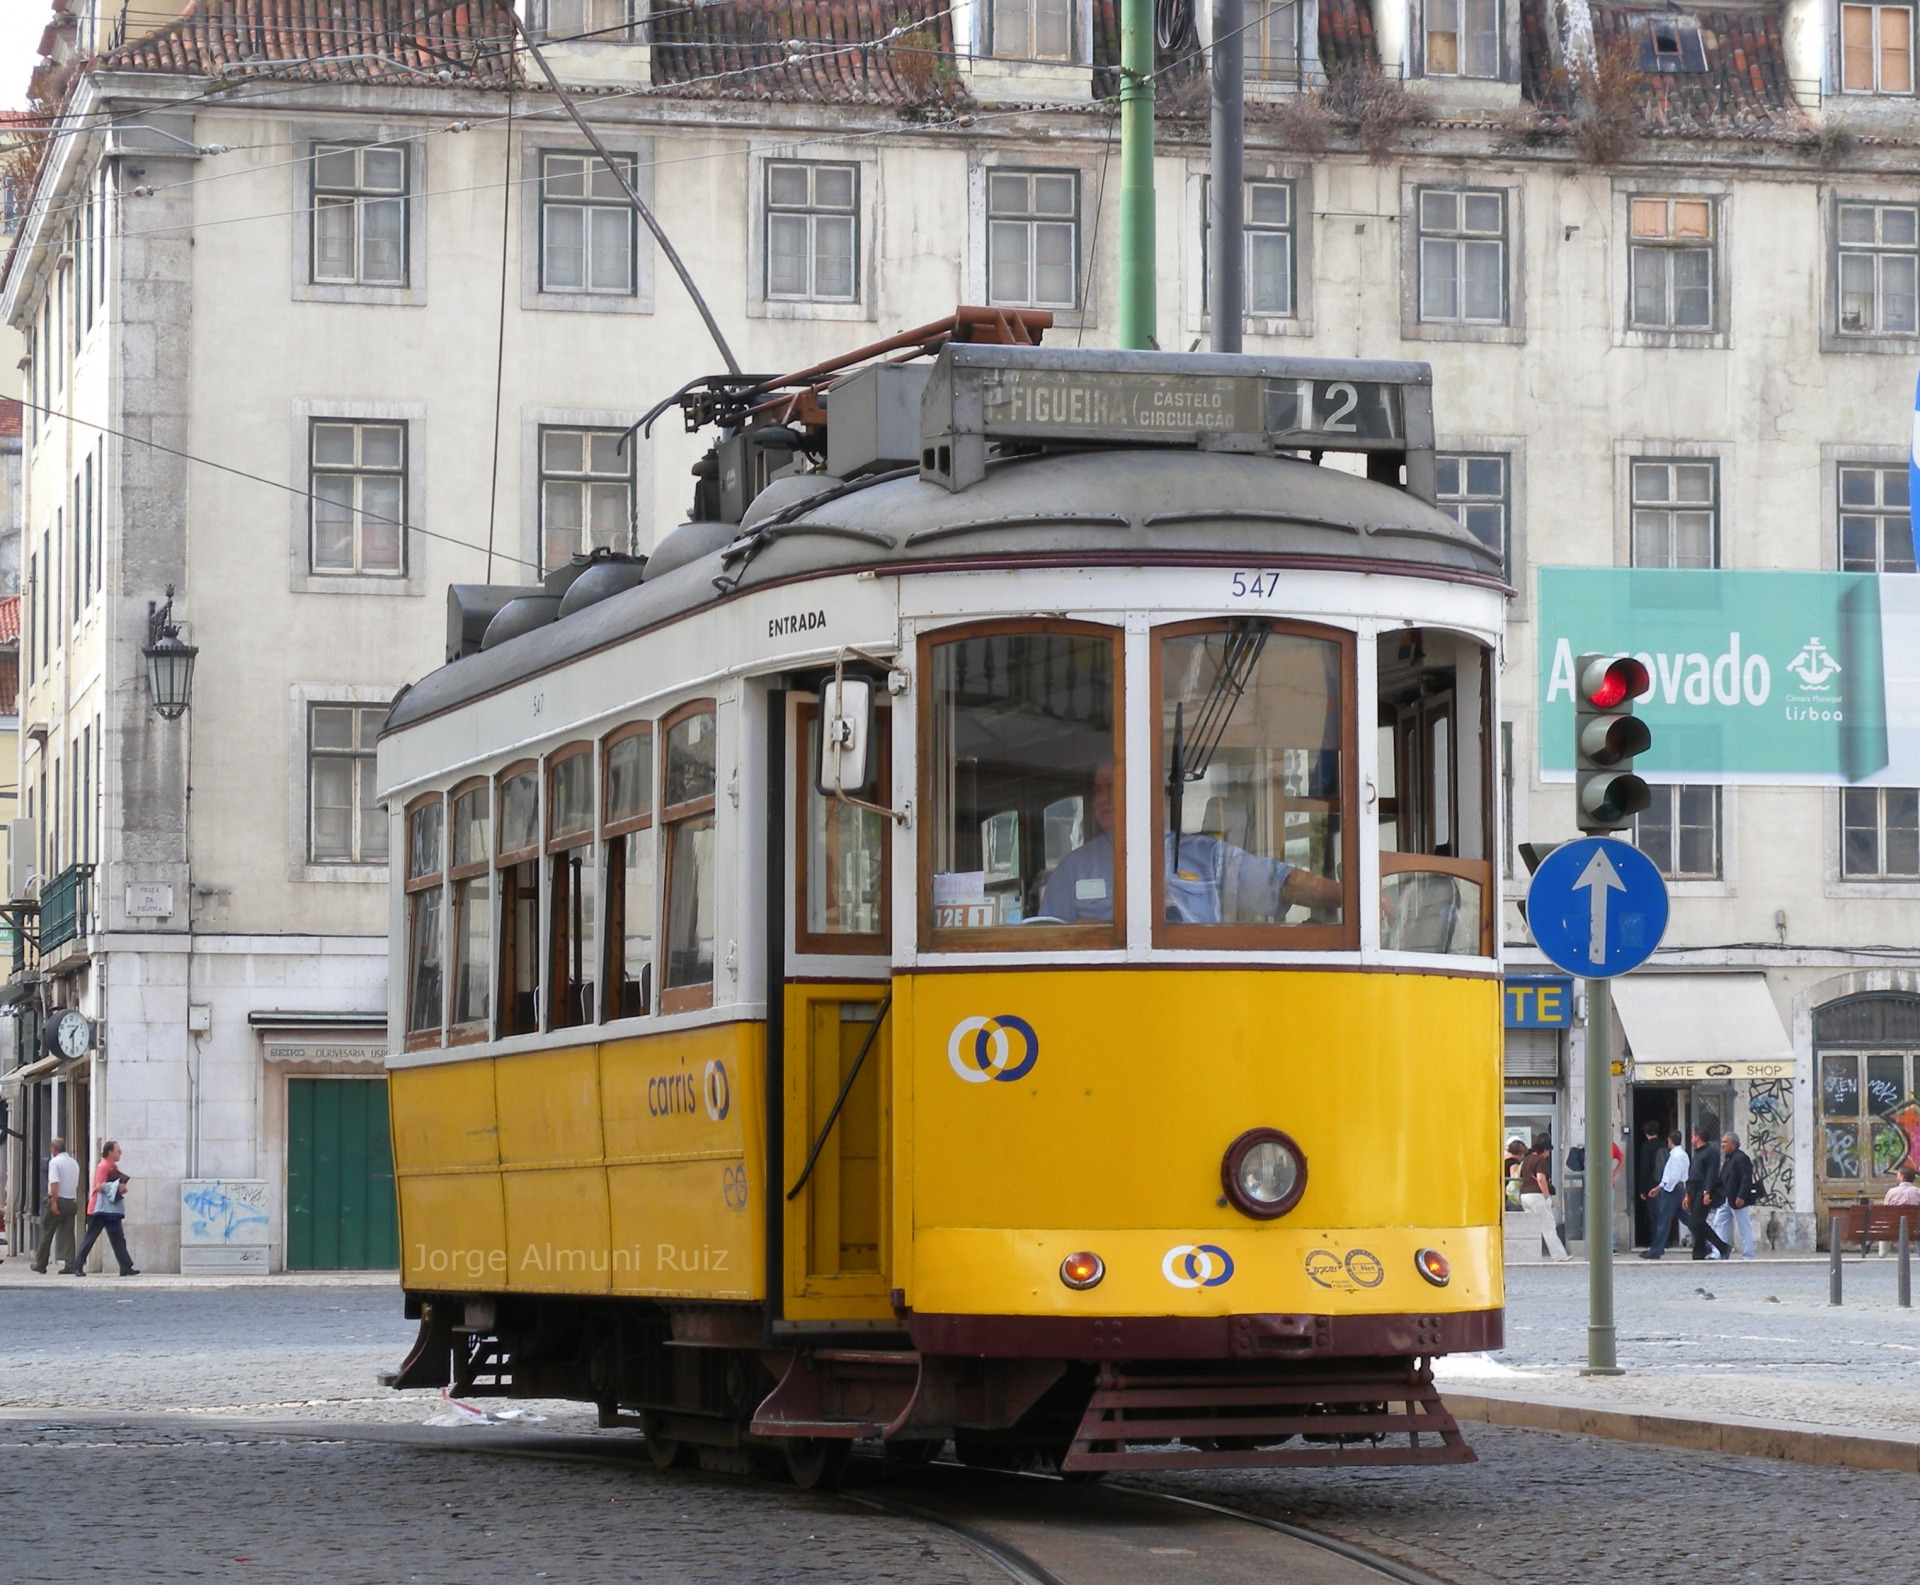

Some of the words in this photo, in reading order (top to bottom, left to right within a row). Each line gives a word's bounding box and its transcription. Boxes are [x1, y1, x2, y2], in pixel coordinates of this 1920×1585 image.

[1011, 386, 1128, 425] FIGUEIRA
[1154, 392, 1221, 408] CASTELO
[1297, 381, 1358, 432] 12
[1140, 411, 1234, 430] CIRCULAÇÃO
[1232, 571, 1280, 598] 547
[768, 609, 827, 638] ENTRADA
[1546, 631, 1772, 706] Aovado
[1785, 706, 1843, 721] Lisboa
[935, 908, 963, 928] 12E
[1506, 987, 1562, 1022] TE
[270, 1049, 305, 1057] SEIKO
[316, 1049, 366, 1058] OURIVESARIA
[1655, 1066, 1695, 1077] SKATE
[1747, 1064, 1782, 1076] SHOP
[648, 1055, 696, 1117] carris
